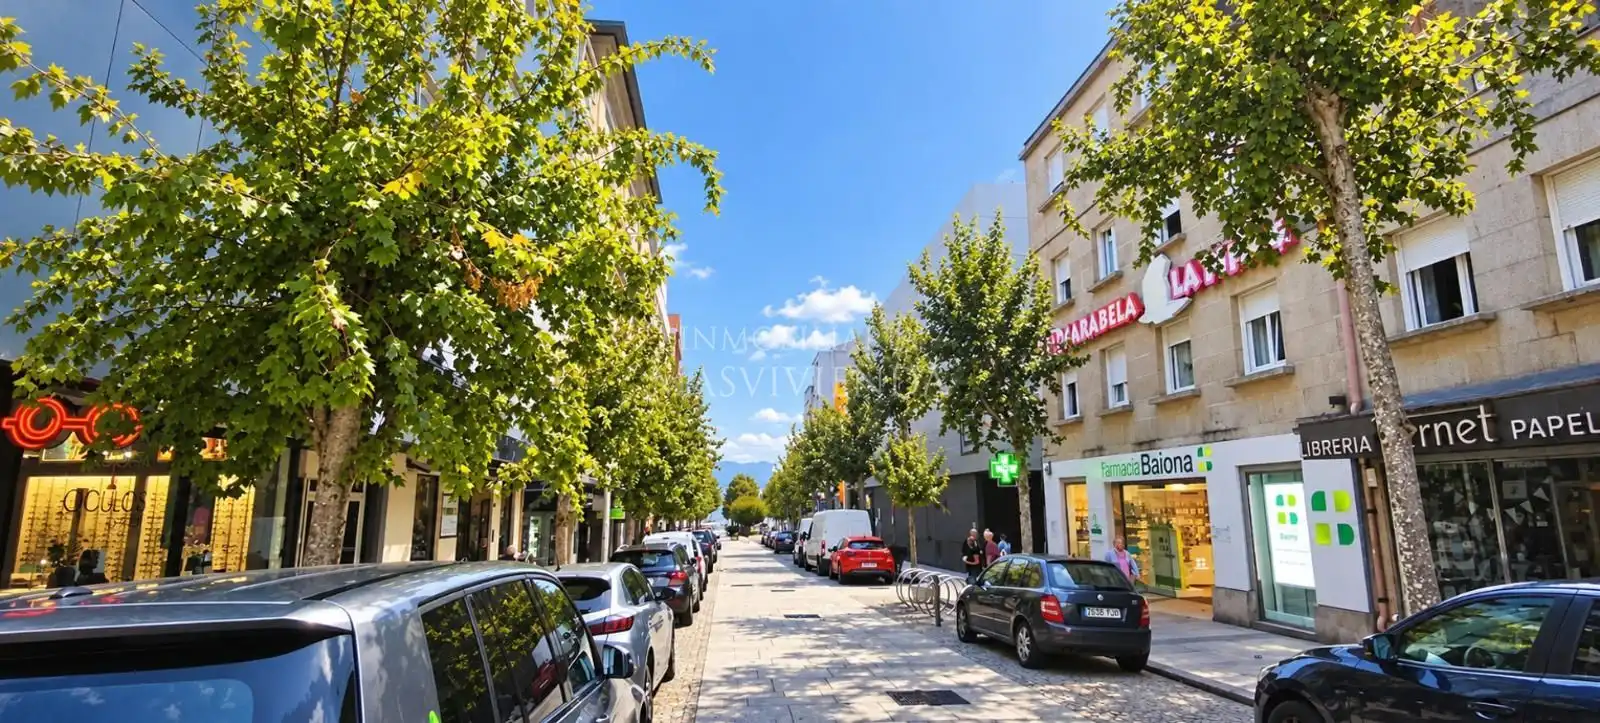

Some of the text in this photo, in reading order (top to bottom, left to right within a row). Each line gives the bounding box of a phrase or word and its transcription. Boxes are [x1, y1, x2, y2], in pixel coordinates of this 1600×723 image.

[1171, 260, 1201, 298] LA
[1301, 404, 1600, 457] LIBRERIA rnet PAPEL
[1101, 451, 1194, 478] Farmacia Baiona
